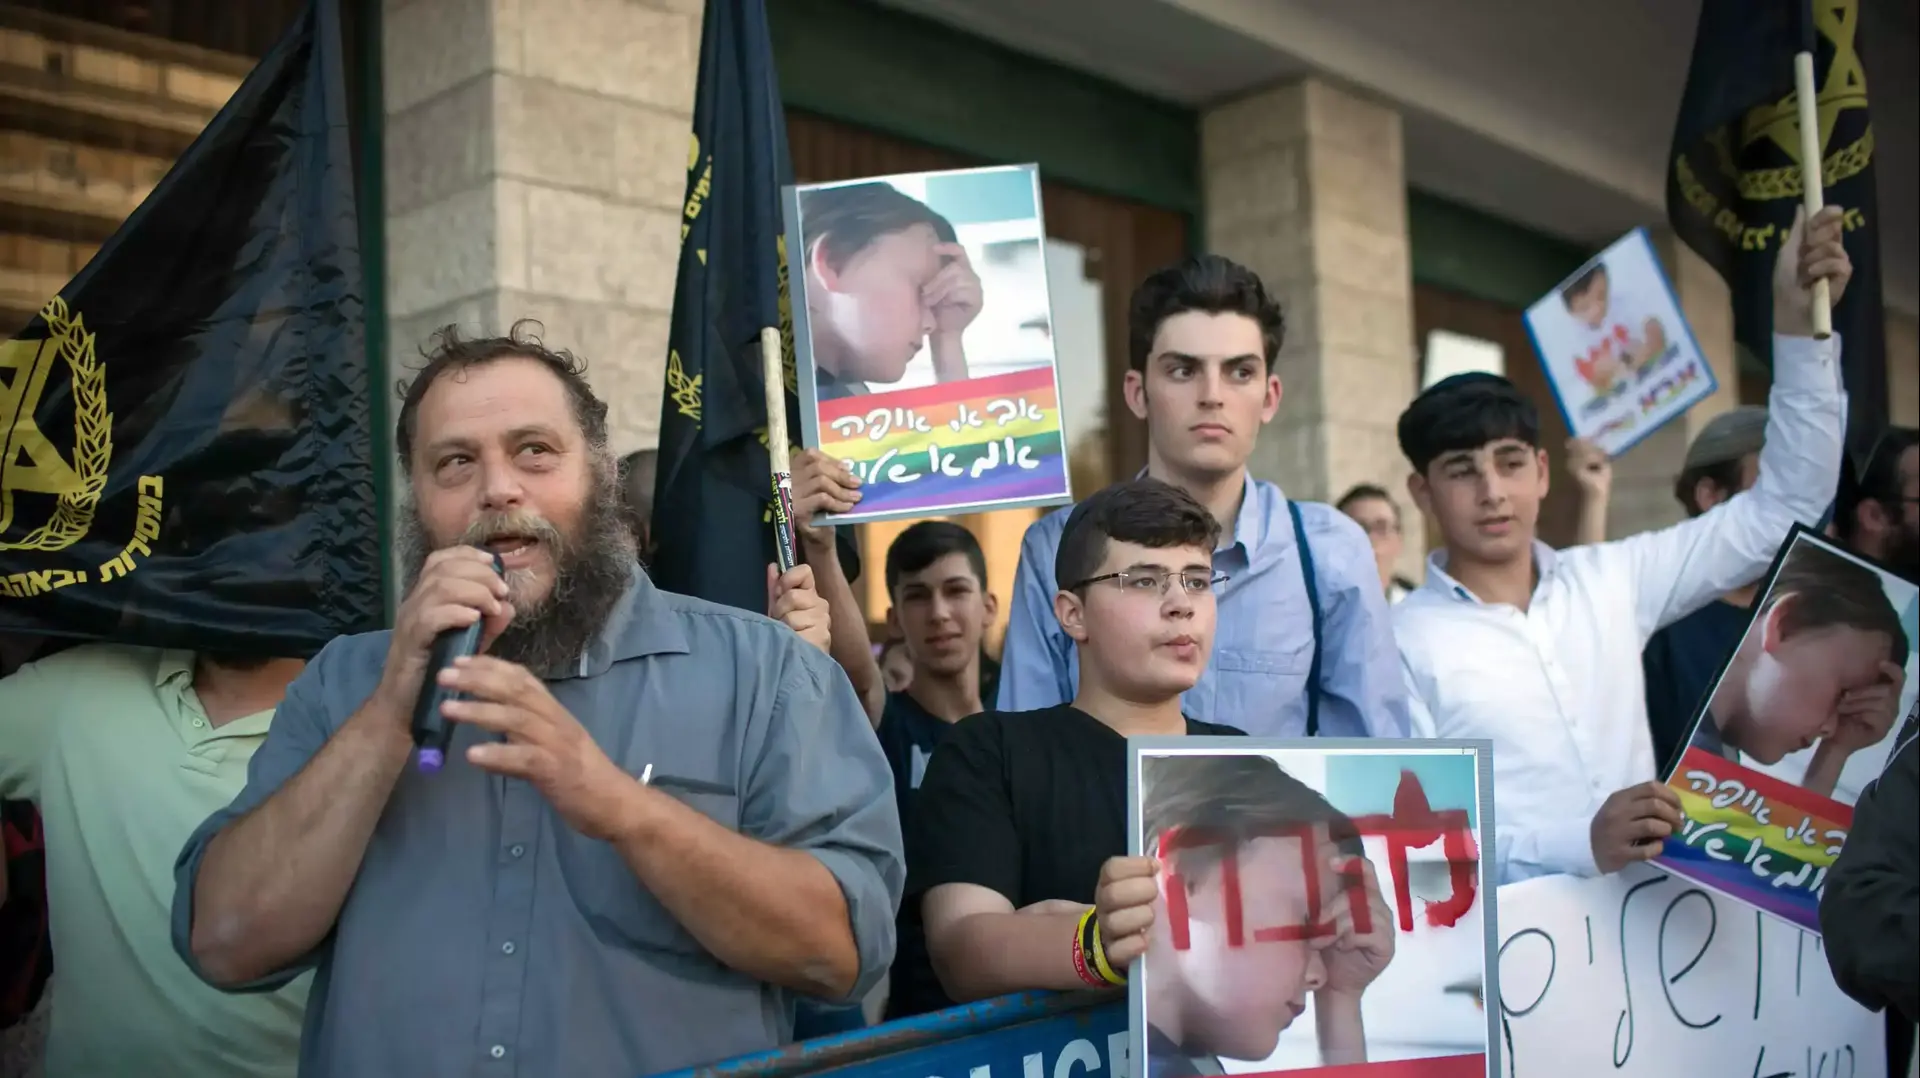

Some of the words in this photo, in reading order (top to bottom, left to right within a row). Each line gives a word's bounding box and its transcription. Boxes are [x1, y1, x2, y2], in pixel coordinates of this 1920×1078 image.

[830, 407, 931, 440] איפה
[928, 436, 1040, 478] אמא
[98, 475, 164, 583] במסירות
[1686, 770, 1770, 825] איפה
[1679, 812, 1733, 861] שלי
[1786, 816, 1848, 856] בא,
